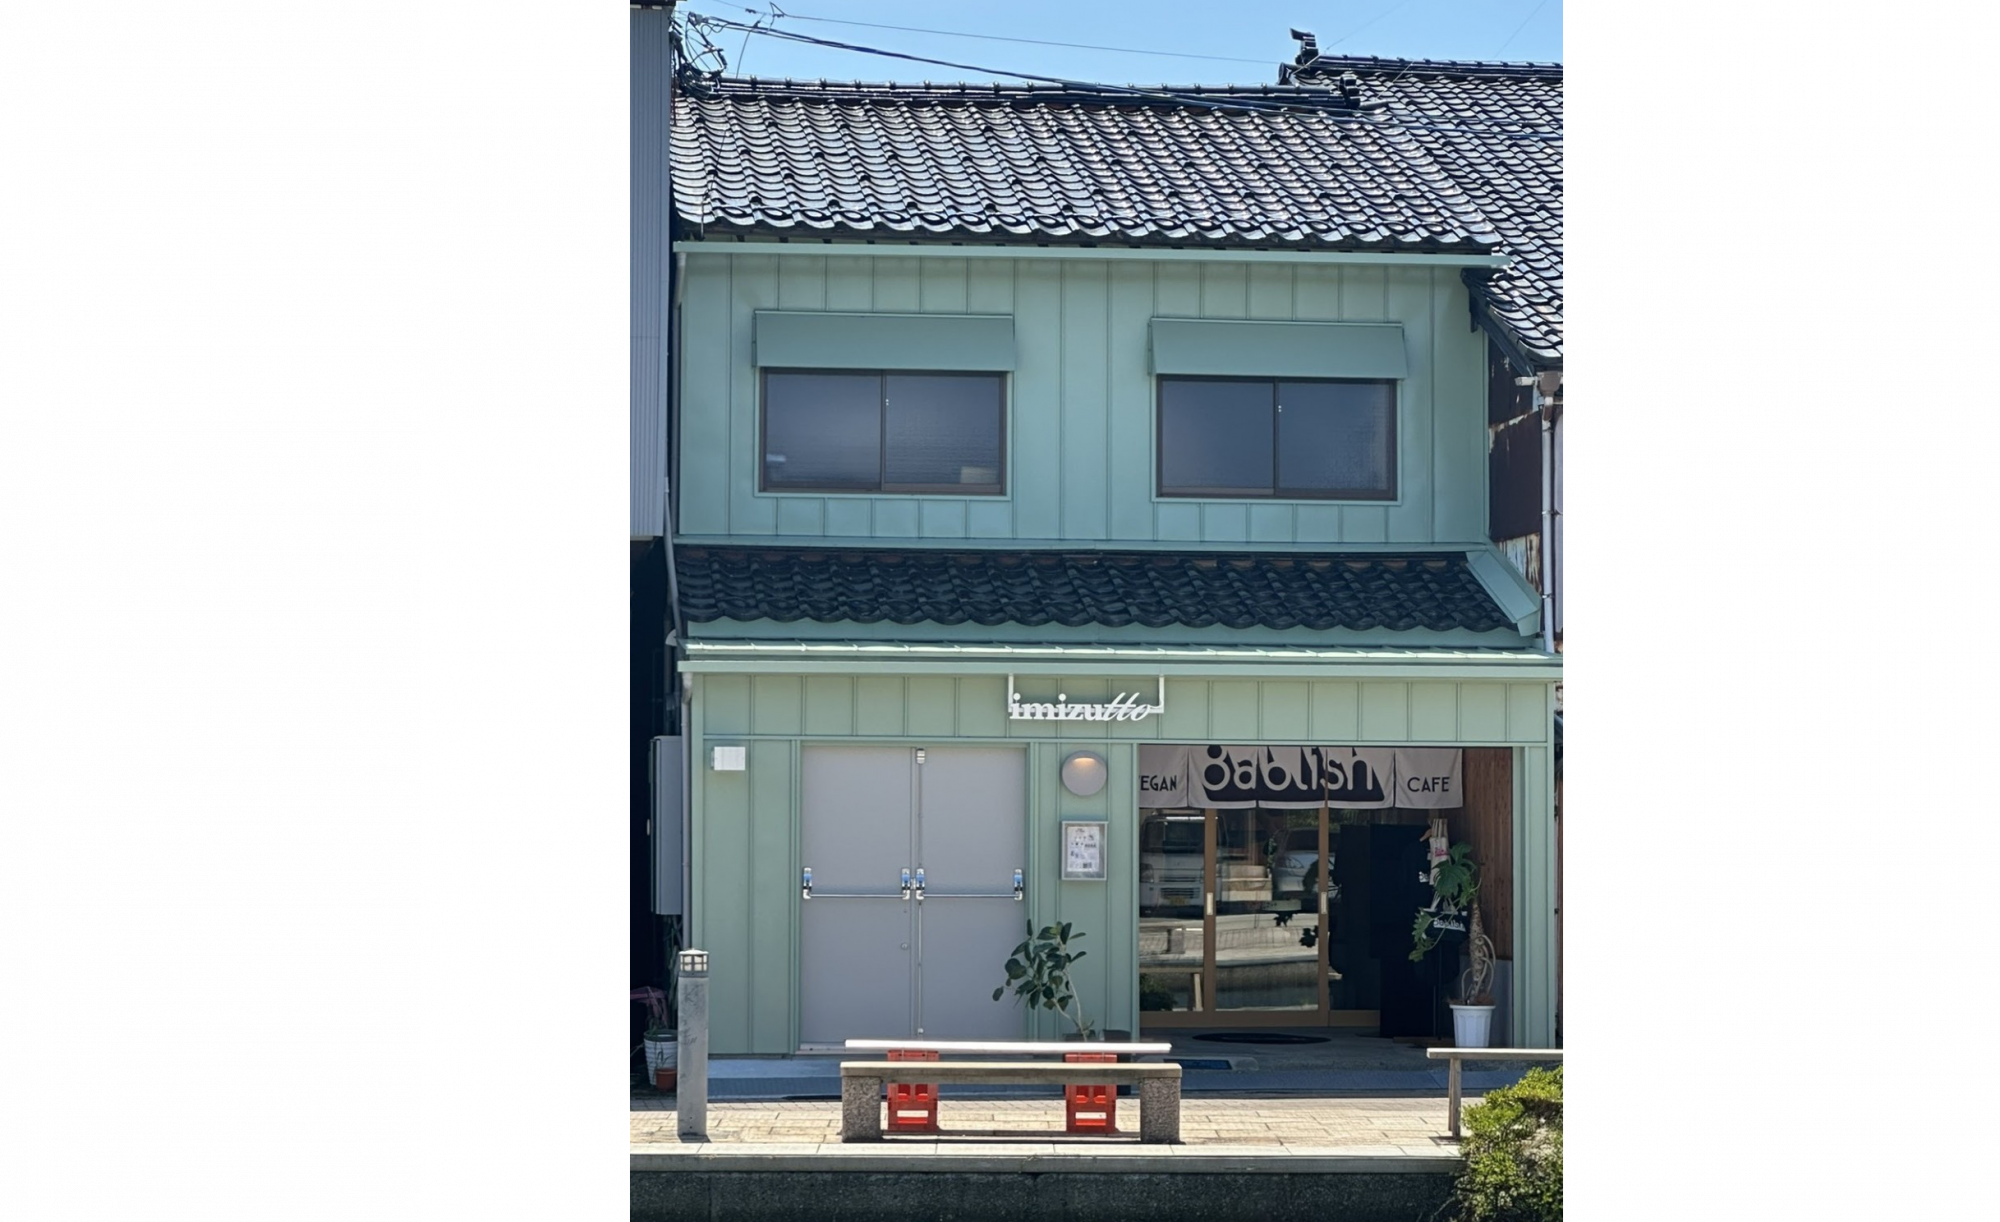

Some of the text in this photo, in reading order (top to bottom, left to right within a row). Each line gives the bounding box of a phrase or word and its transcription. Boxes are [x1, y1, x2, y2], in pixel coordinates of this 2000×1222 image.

[1009, 692, 1151, 721] imizutto
[1138, 774, 1177, 792] EGAN
[1407, 776, 1450, 792] CAFE
